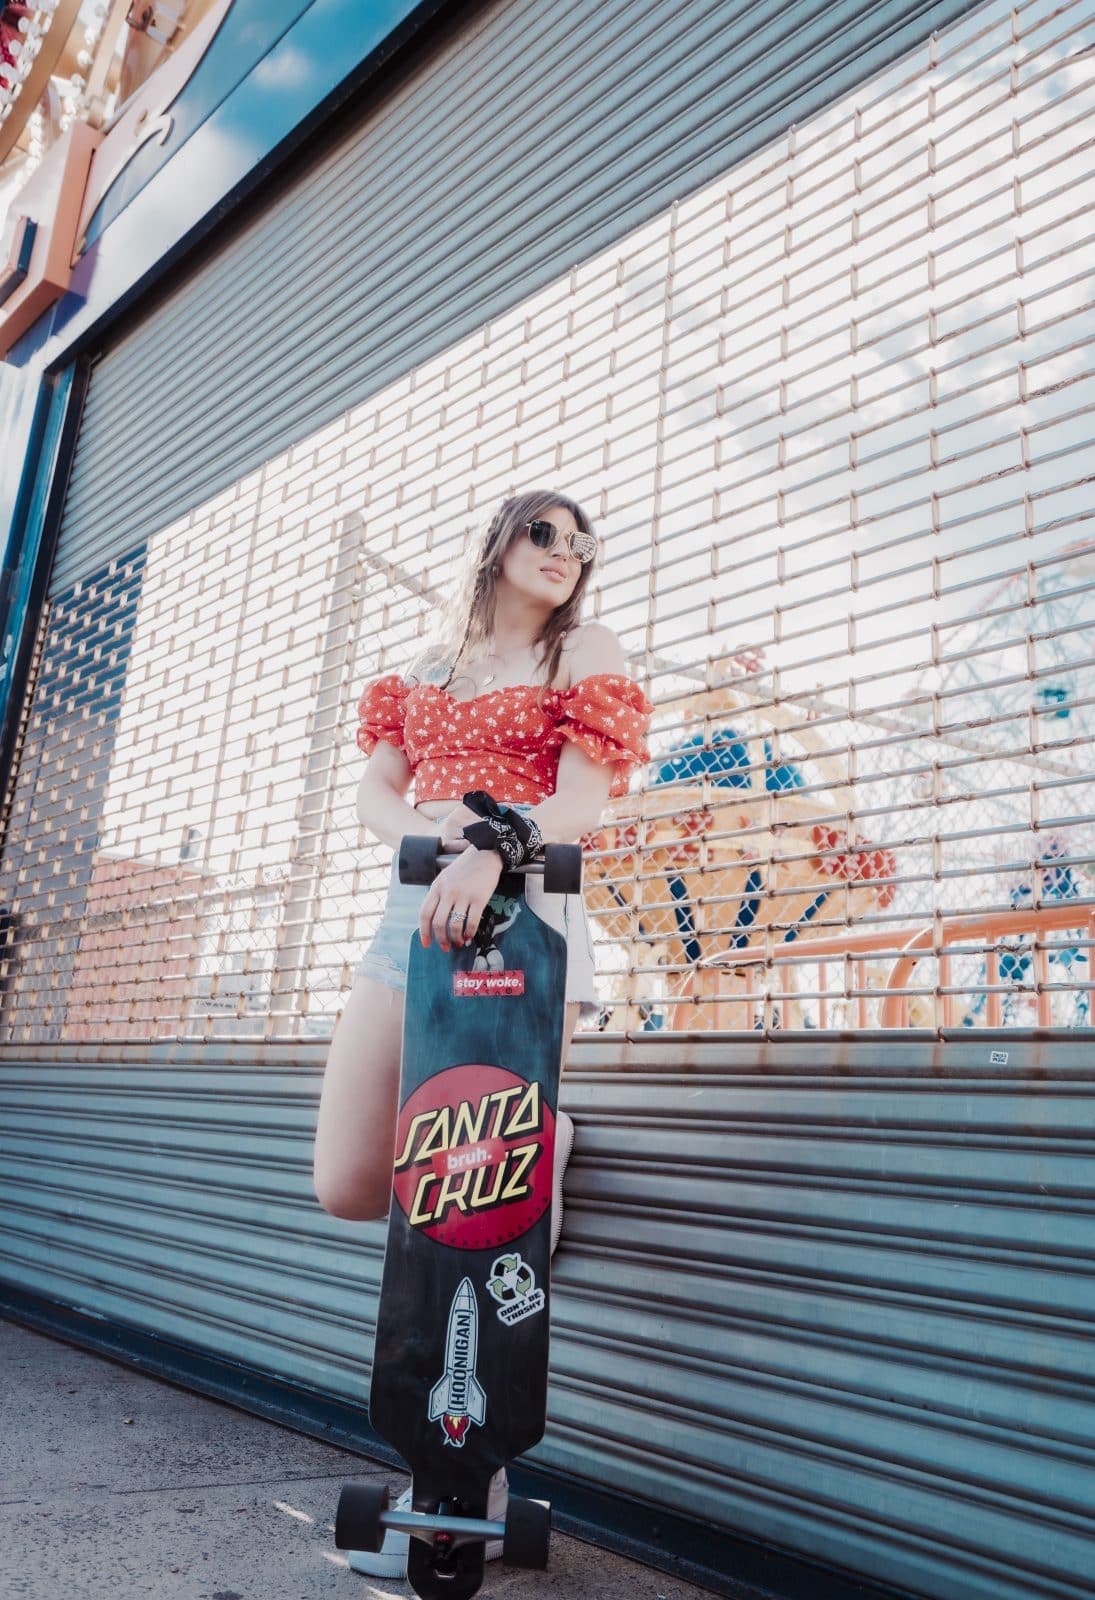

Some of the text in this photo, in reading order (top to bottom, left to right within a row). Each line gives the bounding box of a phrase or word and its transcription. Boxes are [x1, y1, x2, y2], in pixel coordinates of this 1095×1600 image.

[457, 976, 522, 989] stay woke.
[394, 1081, 541, 1169] SANTA
[447, 1147, 492, 1169] bruh.
[410, 1143, 541, 1226] CRUZ
[500, 1299, 526, 1317] DON'T
